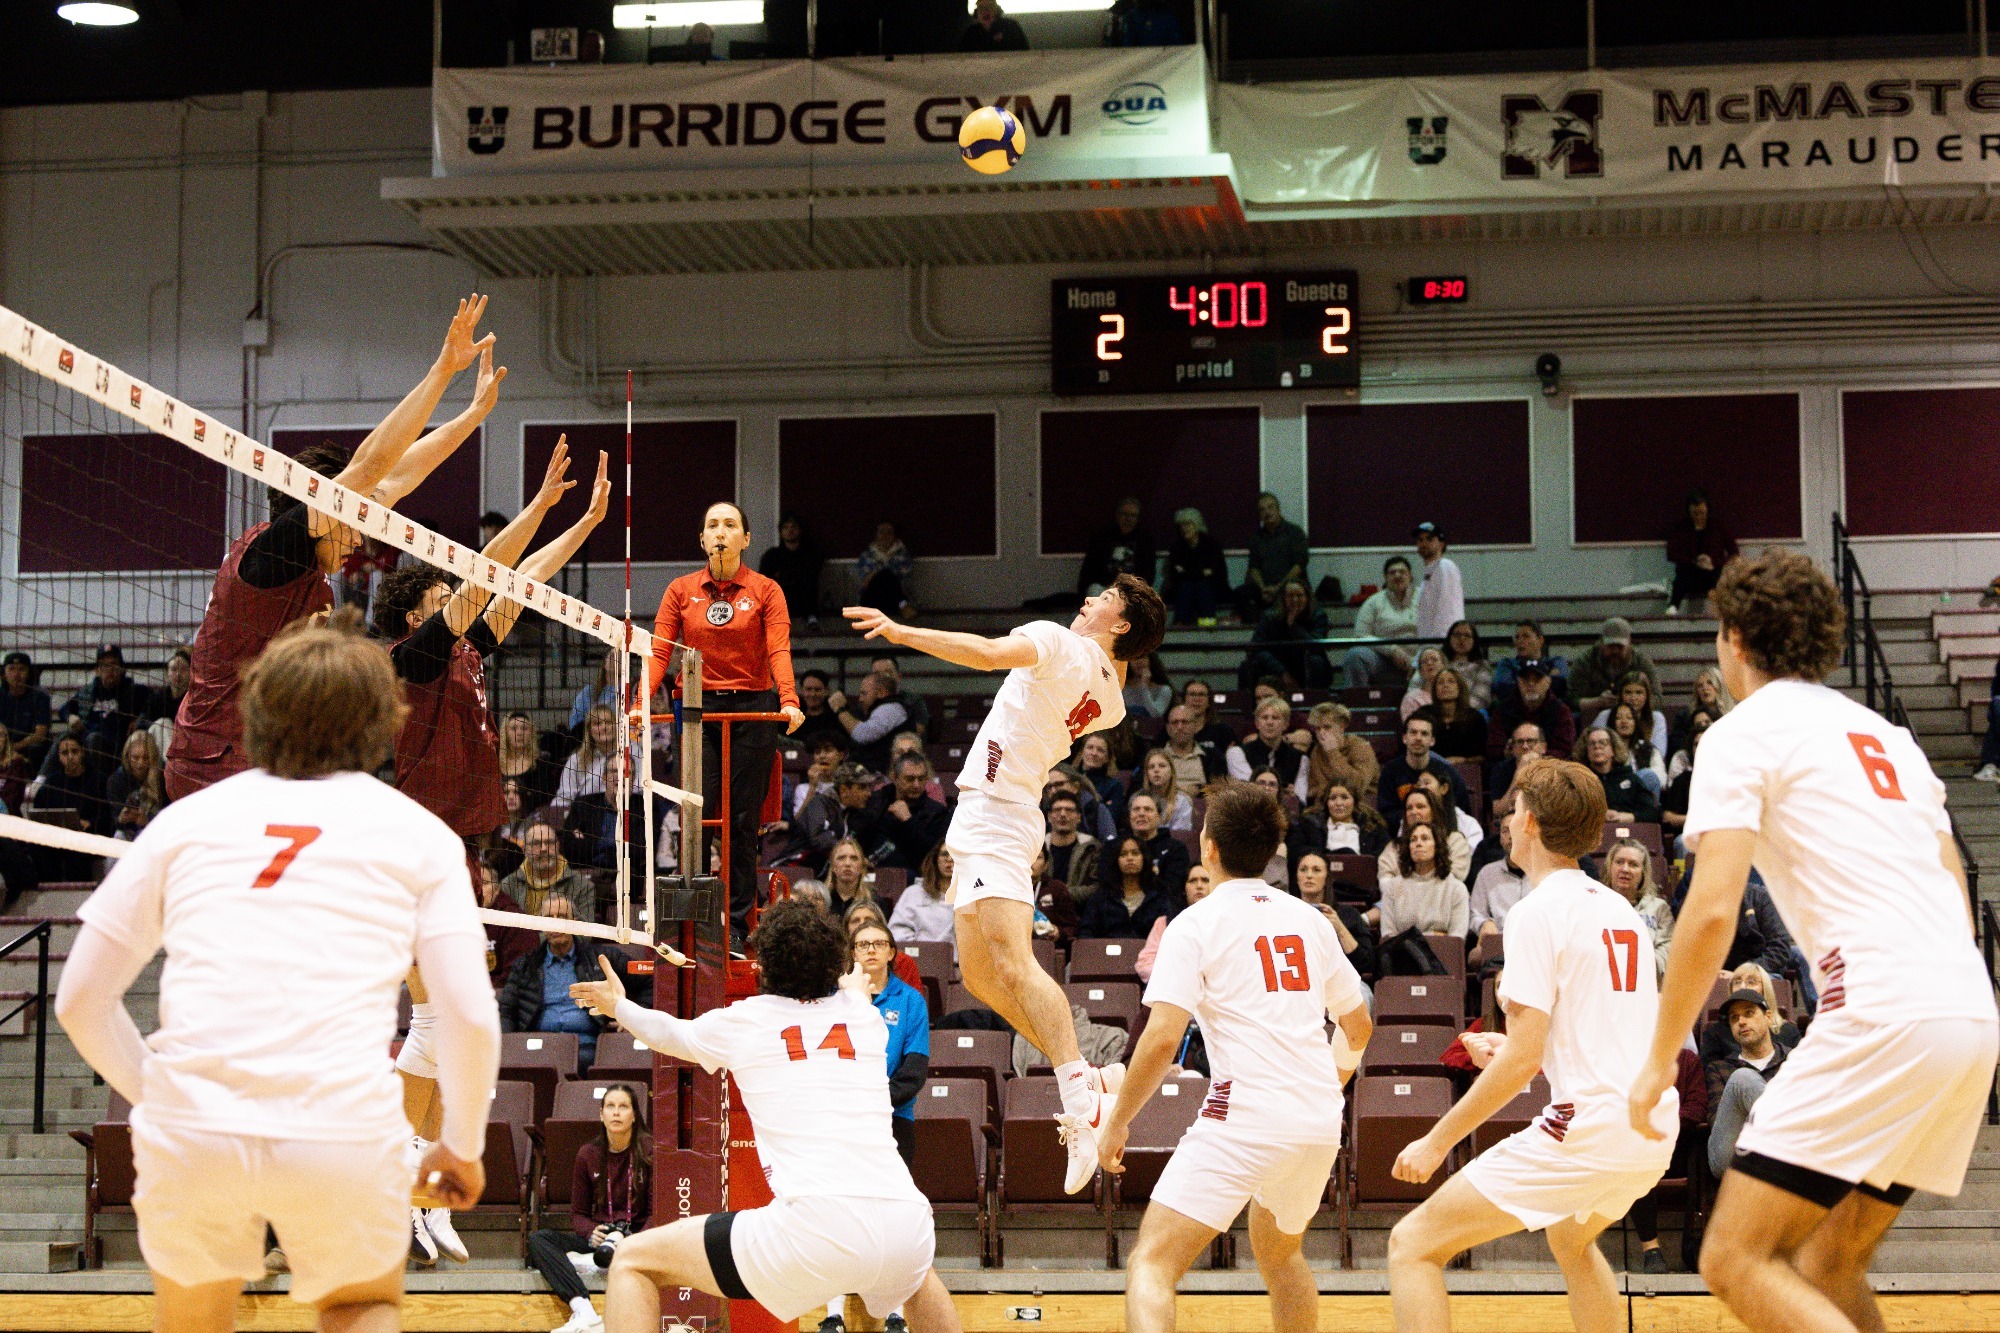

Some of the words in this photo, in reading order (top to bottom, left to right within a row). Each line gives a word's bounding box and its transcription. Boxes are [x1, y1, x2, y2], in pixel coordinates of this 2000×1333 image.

[533, 100, 886, 150] BURRIDGE
[1102, 97, 1167, 113] OUA
[1067, 287, 1117, 309] Home
[1169, 281, 1268, 328] 4:00
[1286, 280, 1349, 302] Guests
[1097, 313, 1125, 361] 2
[1322, 307, 1350, 354] 2
[1175, 358, 1234, 384] period
[1847, 732, 1907, 802] 6
[249, 823, 322, 889] 7
[1254, 934, 1310, 992] 13
[1602, 928, 1639, 992] 17
[780, 1022, 857, 1061] 14
